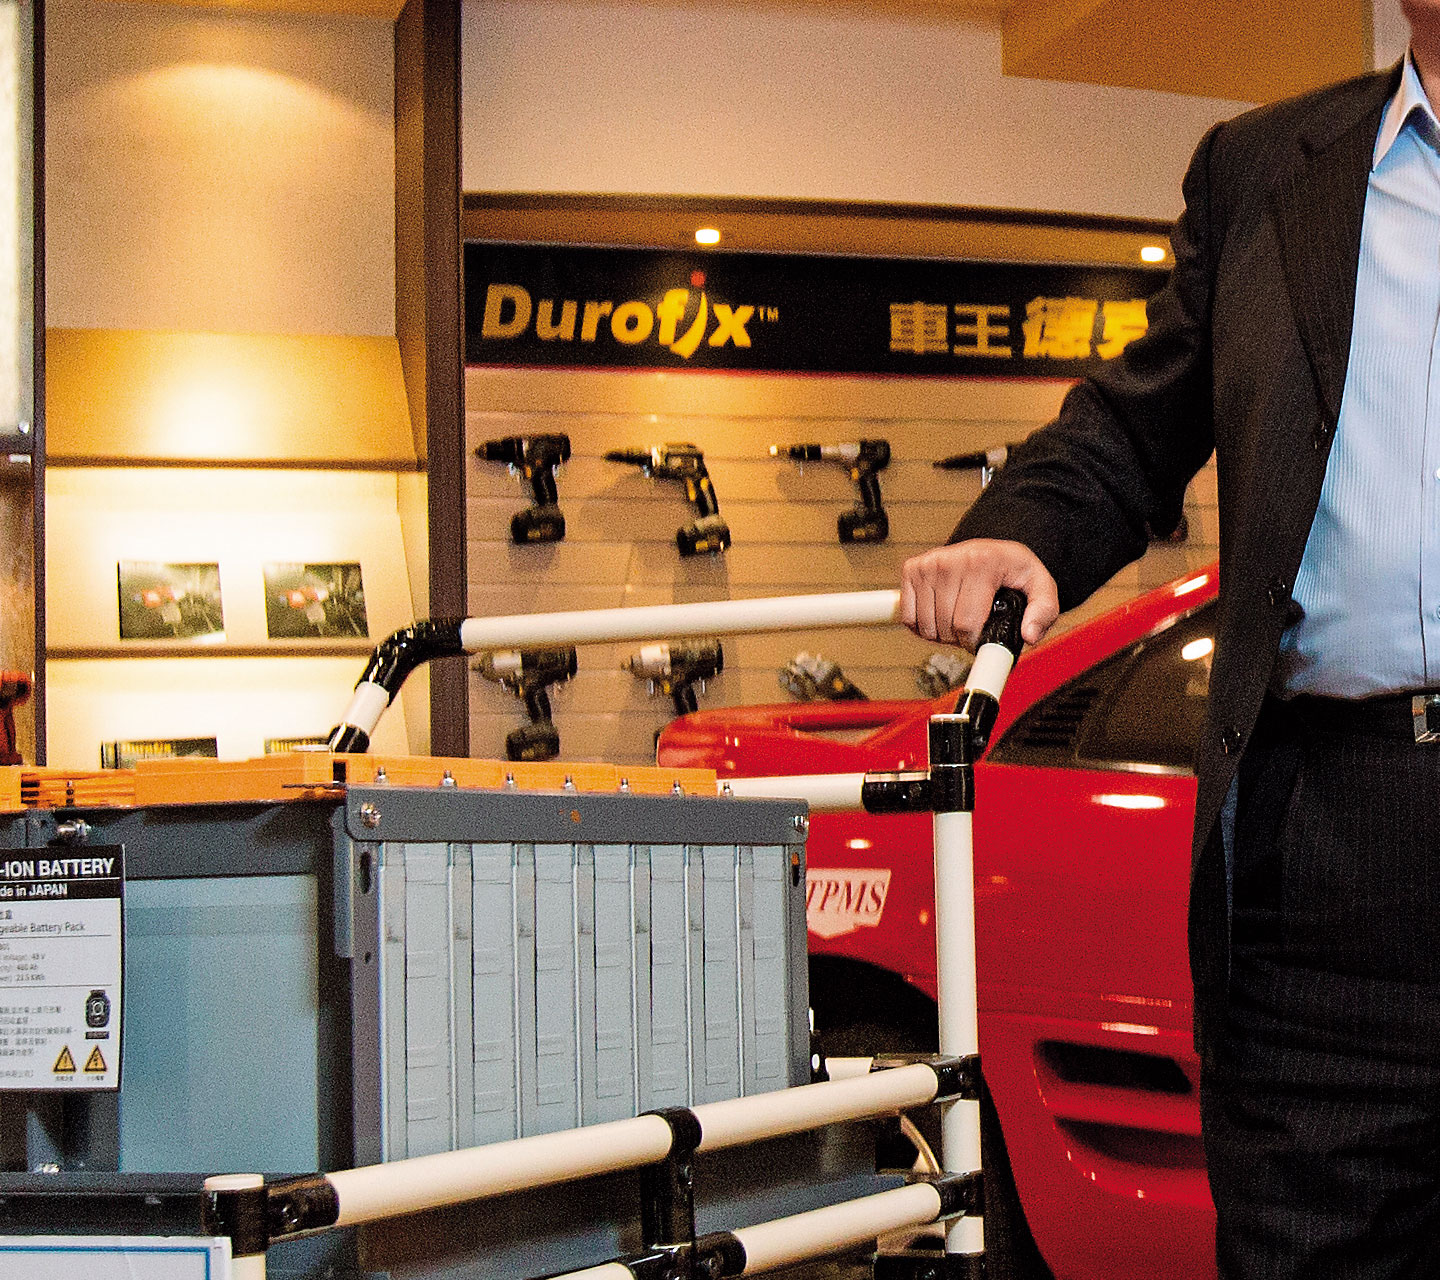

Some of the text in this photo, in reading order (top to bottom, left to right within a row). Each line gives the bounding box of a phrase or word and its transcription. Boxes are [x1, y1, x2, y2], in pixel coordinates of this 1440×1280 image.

[38, 858, 115, 877] BATTERY
[16, 884, 27, 896] in
[29, 883, 68, 896] JAPAN
[807, 880, 886, 914] TPMS
[30, 922, 62, 935] Battery
[65, 921, 86, 932] Pack
